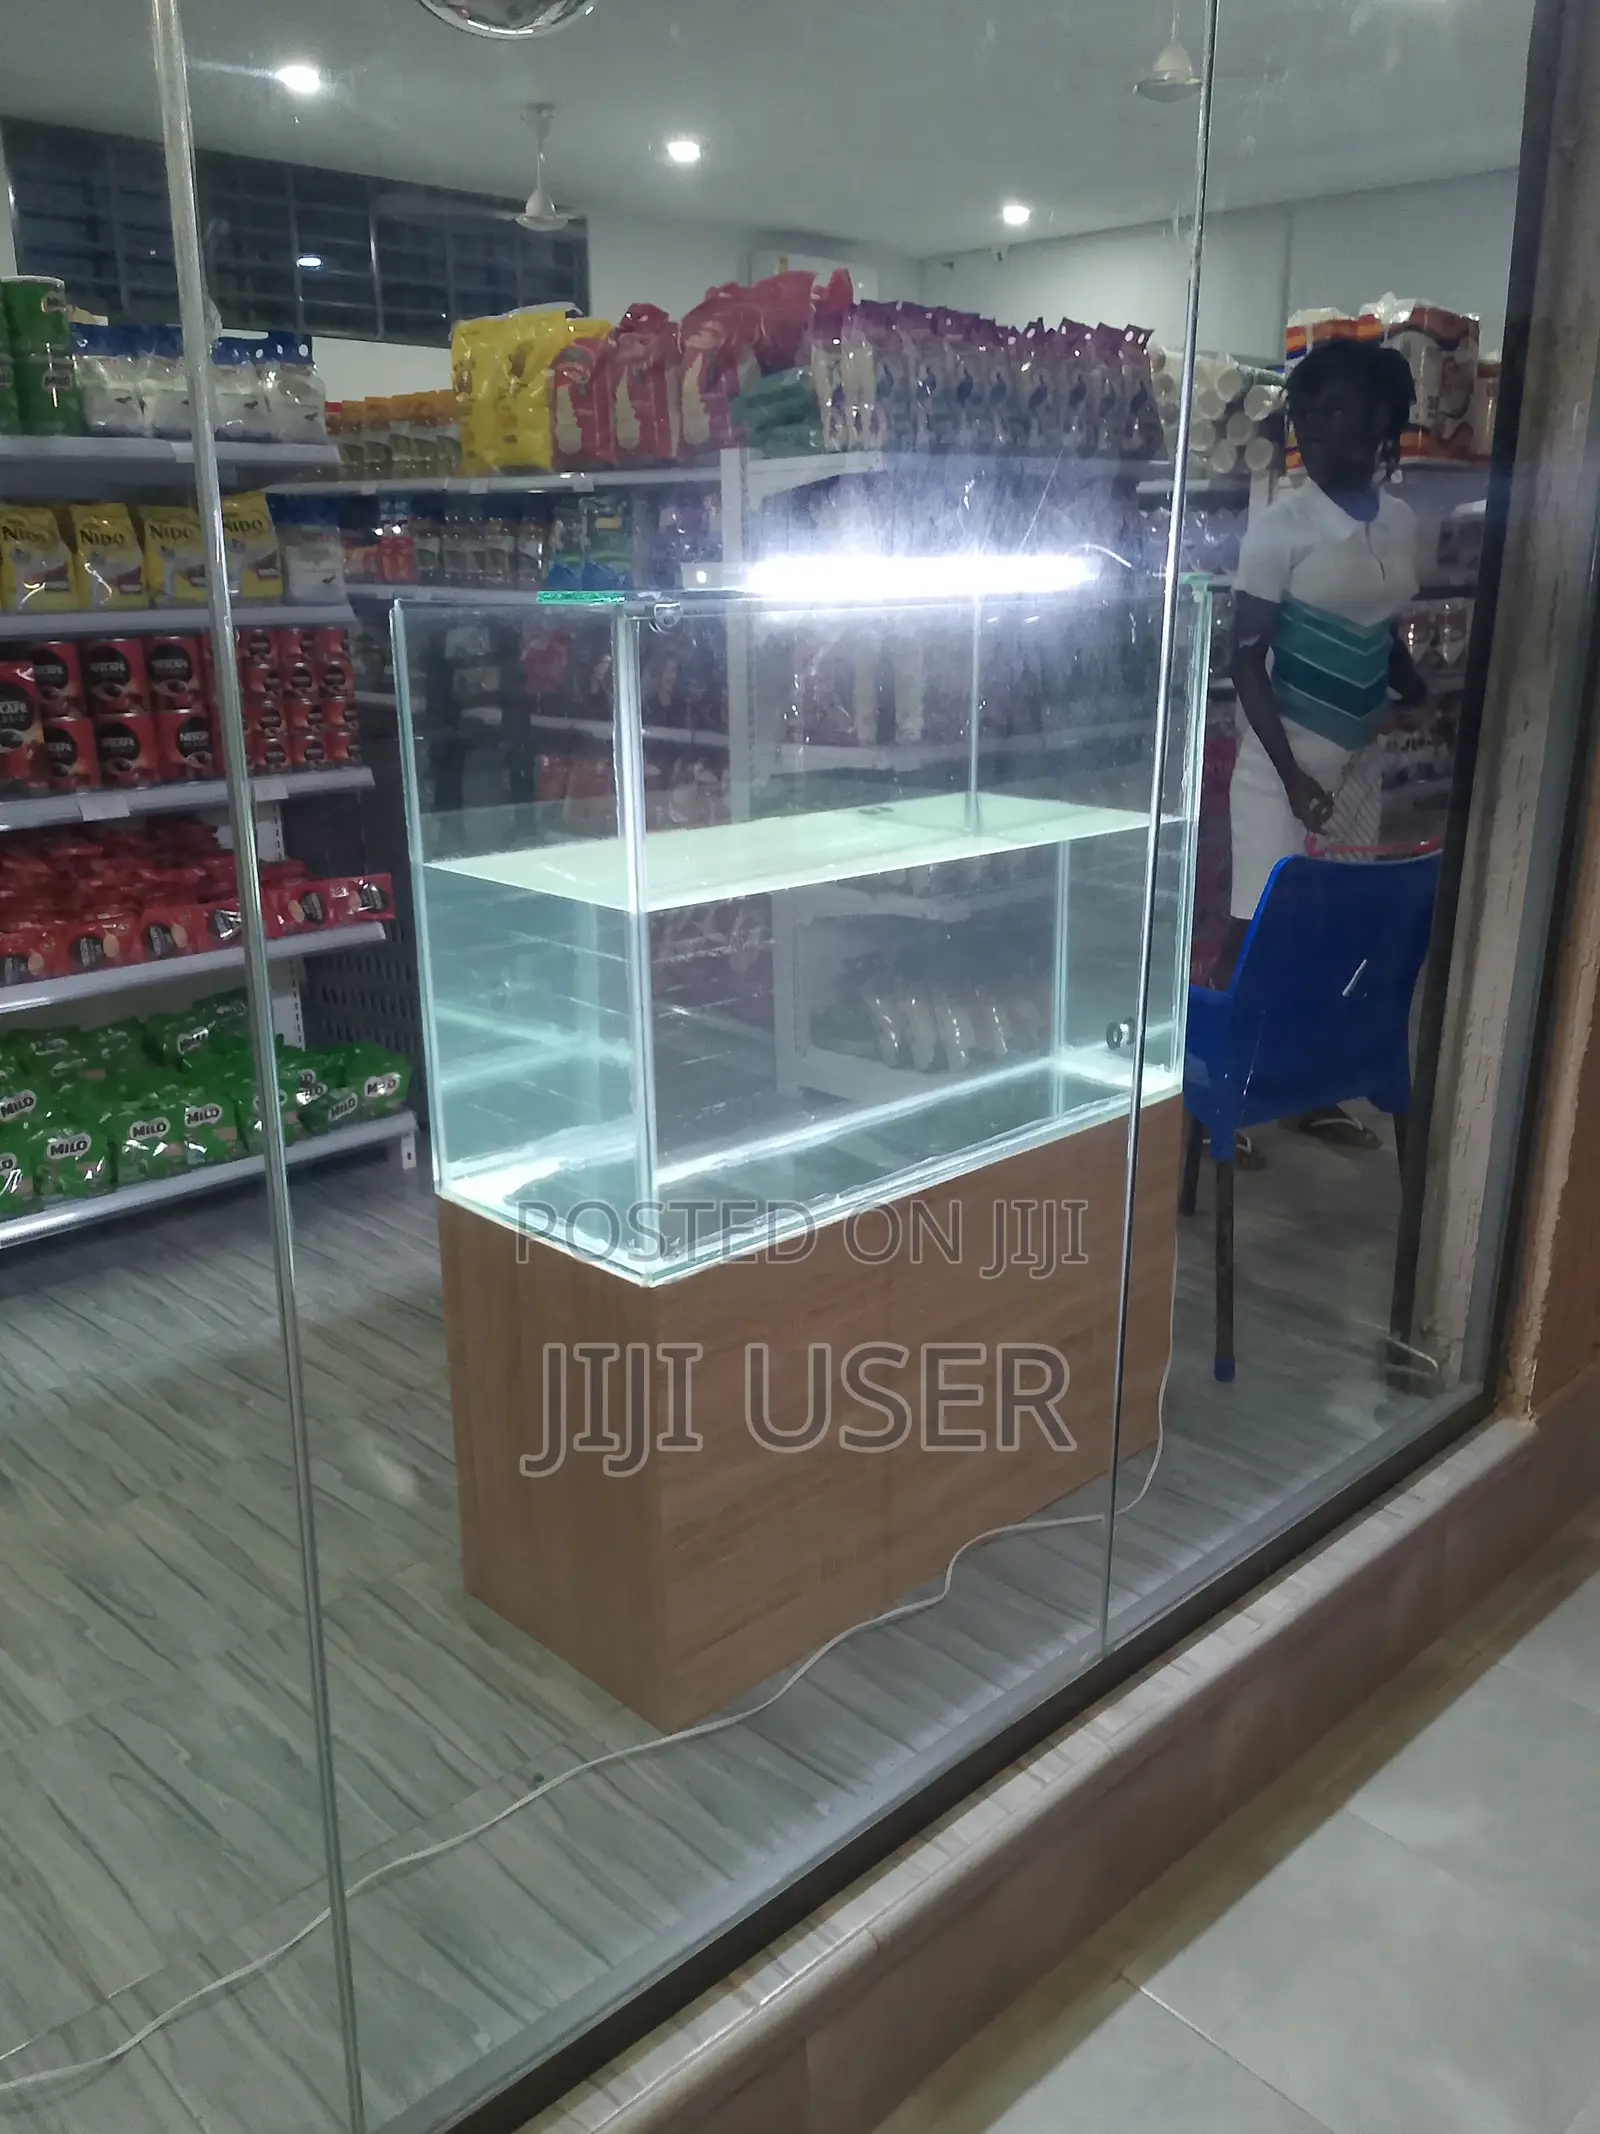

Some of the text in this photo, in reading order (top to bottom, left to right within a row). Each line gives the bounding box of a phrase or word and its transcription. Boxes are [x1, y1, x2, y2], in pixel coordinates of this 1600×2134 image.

[79, 528, 125, 546] NIDO
[149, 523, 195, 541] NIDO
[0, 1096, 34, 1118] MILO
[186, 1107, 220, 1125] MILO
[330, 1097, 356, 1119] MILO
[132, 1121, 167, 1138] MILO
[50, 1140, 88, 1156] MILO
